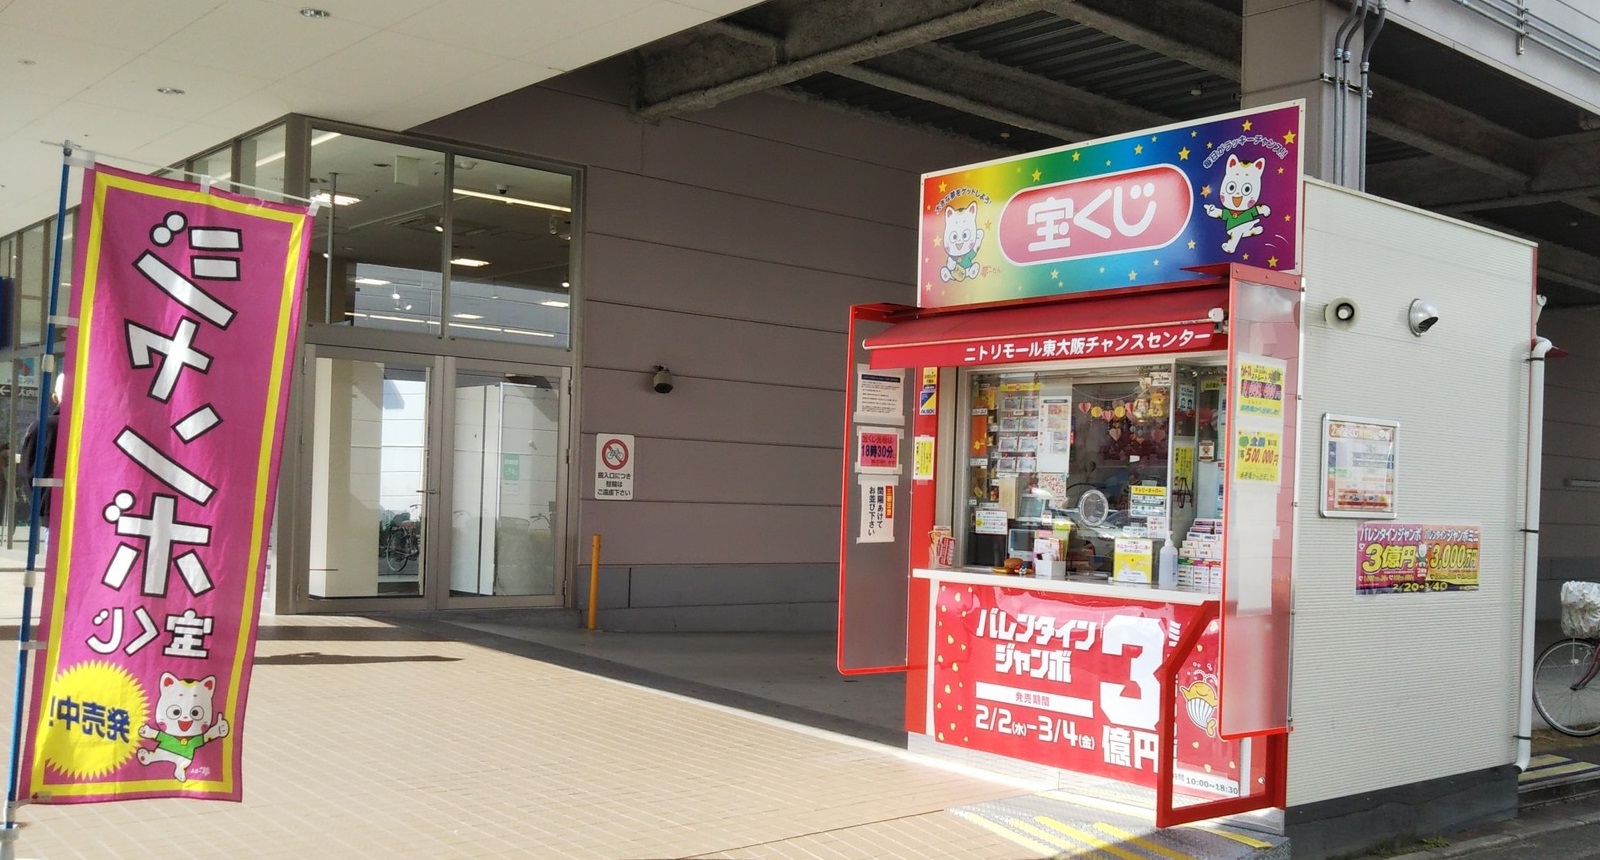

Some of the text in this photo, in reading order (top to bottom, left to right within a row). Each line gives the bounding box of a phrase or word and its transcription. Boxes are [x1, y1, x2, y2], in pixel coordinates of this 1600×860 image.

[1026, 182, 1157, 252] 宝くじ
[964, 328, 1211, 362] ニトリモール東大阪チャンスセンター
[861, 445, 893, 459] 18時30分
[597, 488, 631, 497] ご遠慮下さい
[606, 480, 623, 488] 駐輪は
[868, 486, 876, 536] お並び下さい
[876, 486, 884, 527] 間隔あけて
[1360, 528, 1422, 541] バレンタインジャンボ
[1362, 543, 1418, 573] 3億円
[976, 607, 1098, 651] バレンタイン
[995, 643, 1071, 683] ジャンボ
[1101, 614, 1165, 731] 3
[1015, 691, 1050, 707] 発売期間
[1101, 724, 1160, 773] 億円
